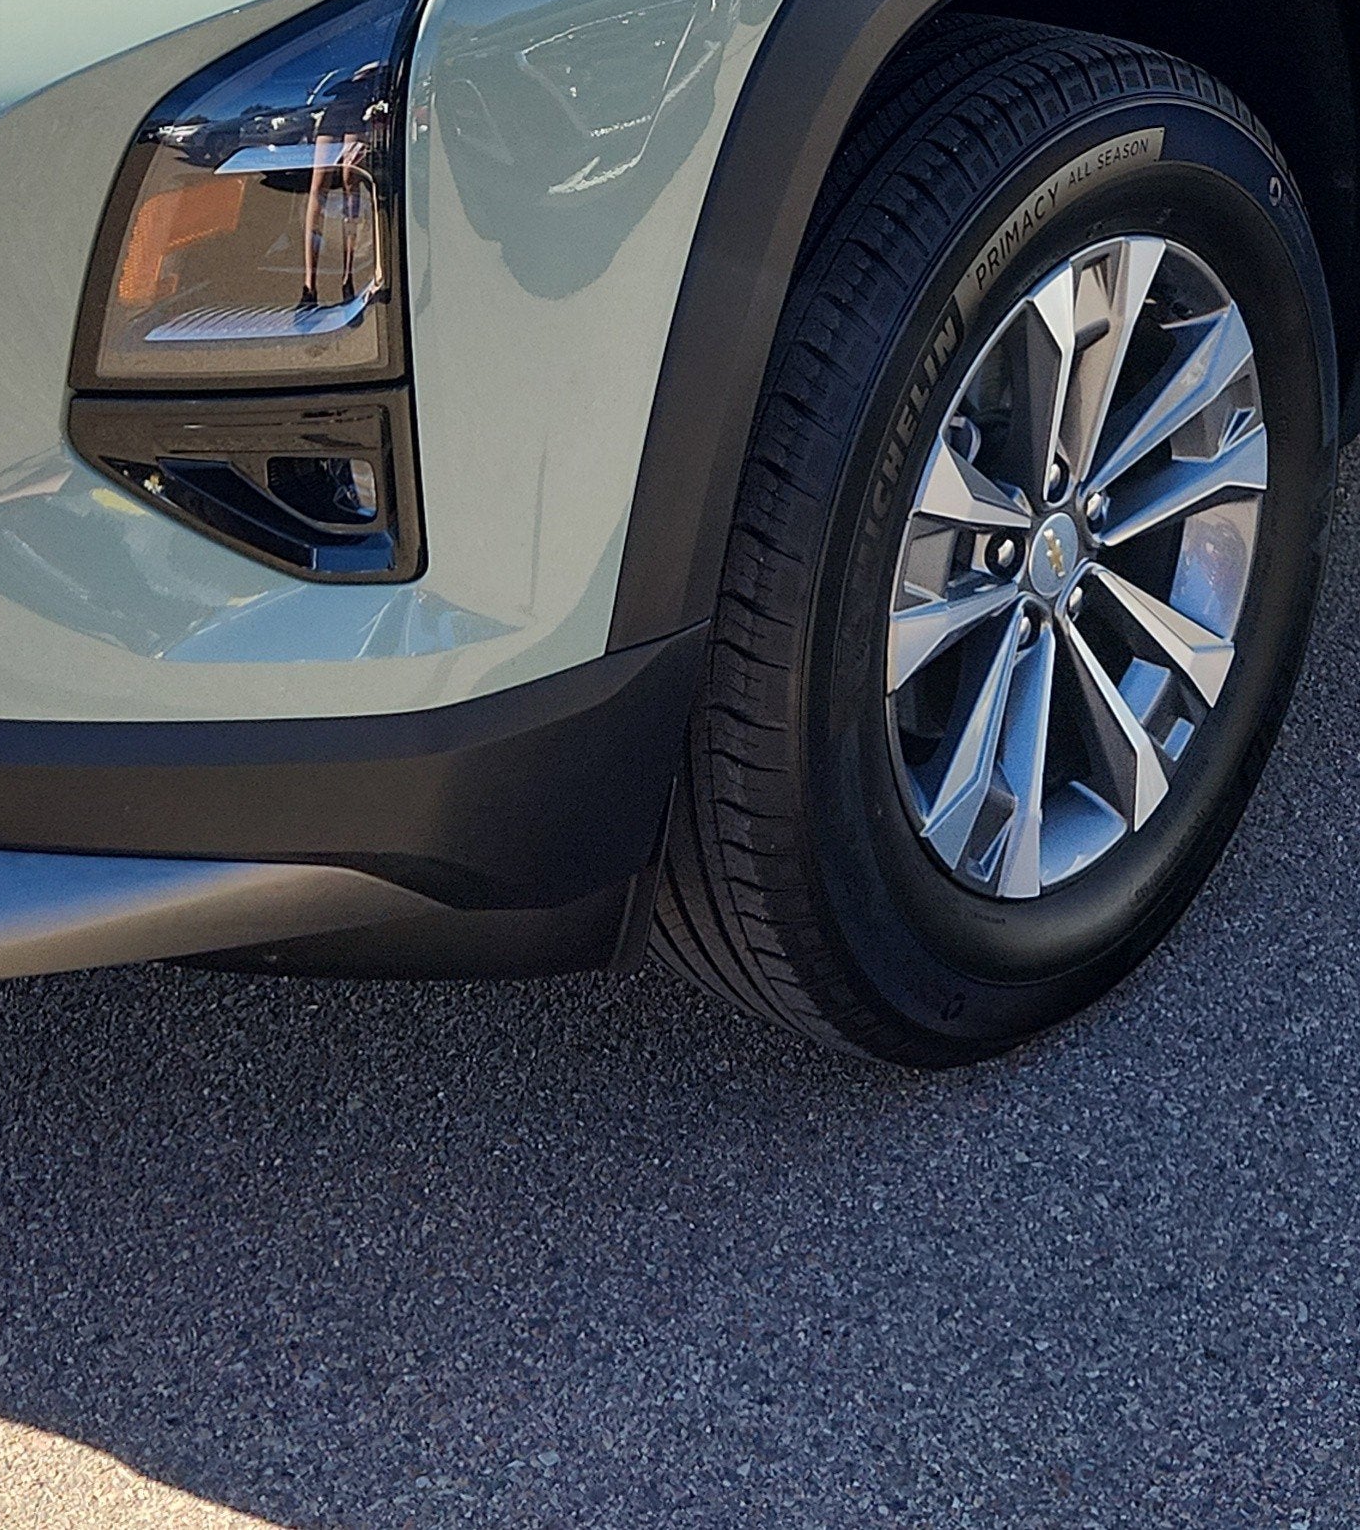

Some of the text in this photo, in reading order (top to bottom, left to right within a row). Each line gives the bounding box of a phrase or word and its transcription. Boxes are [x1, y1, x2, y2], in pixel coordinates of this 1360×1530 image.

[976, 138, 1149, 290] PRIMACY ALL SEASON
